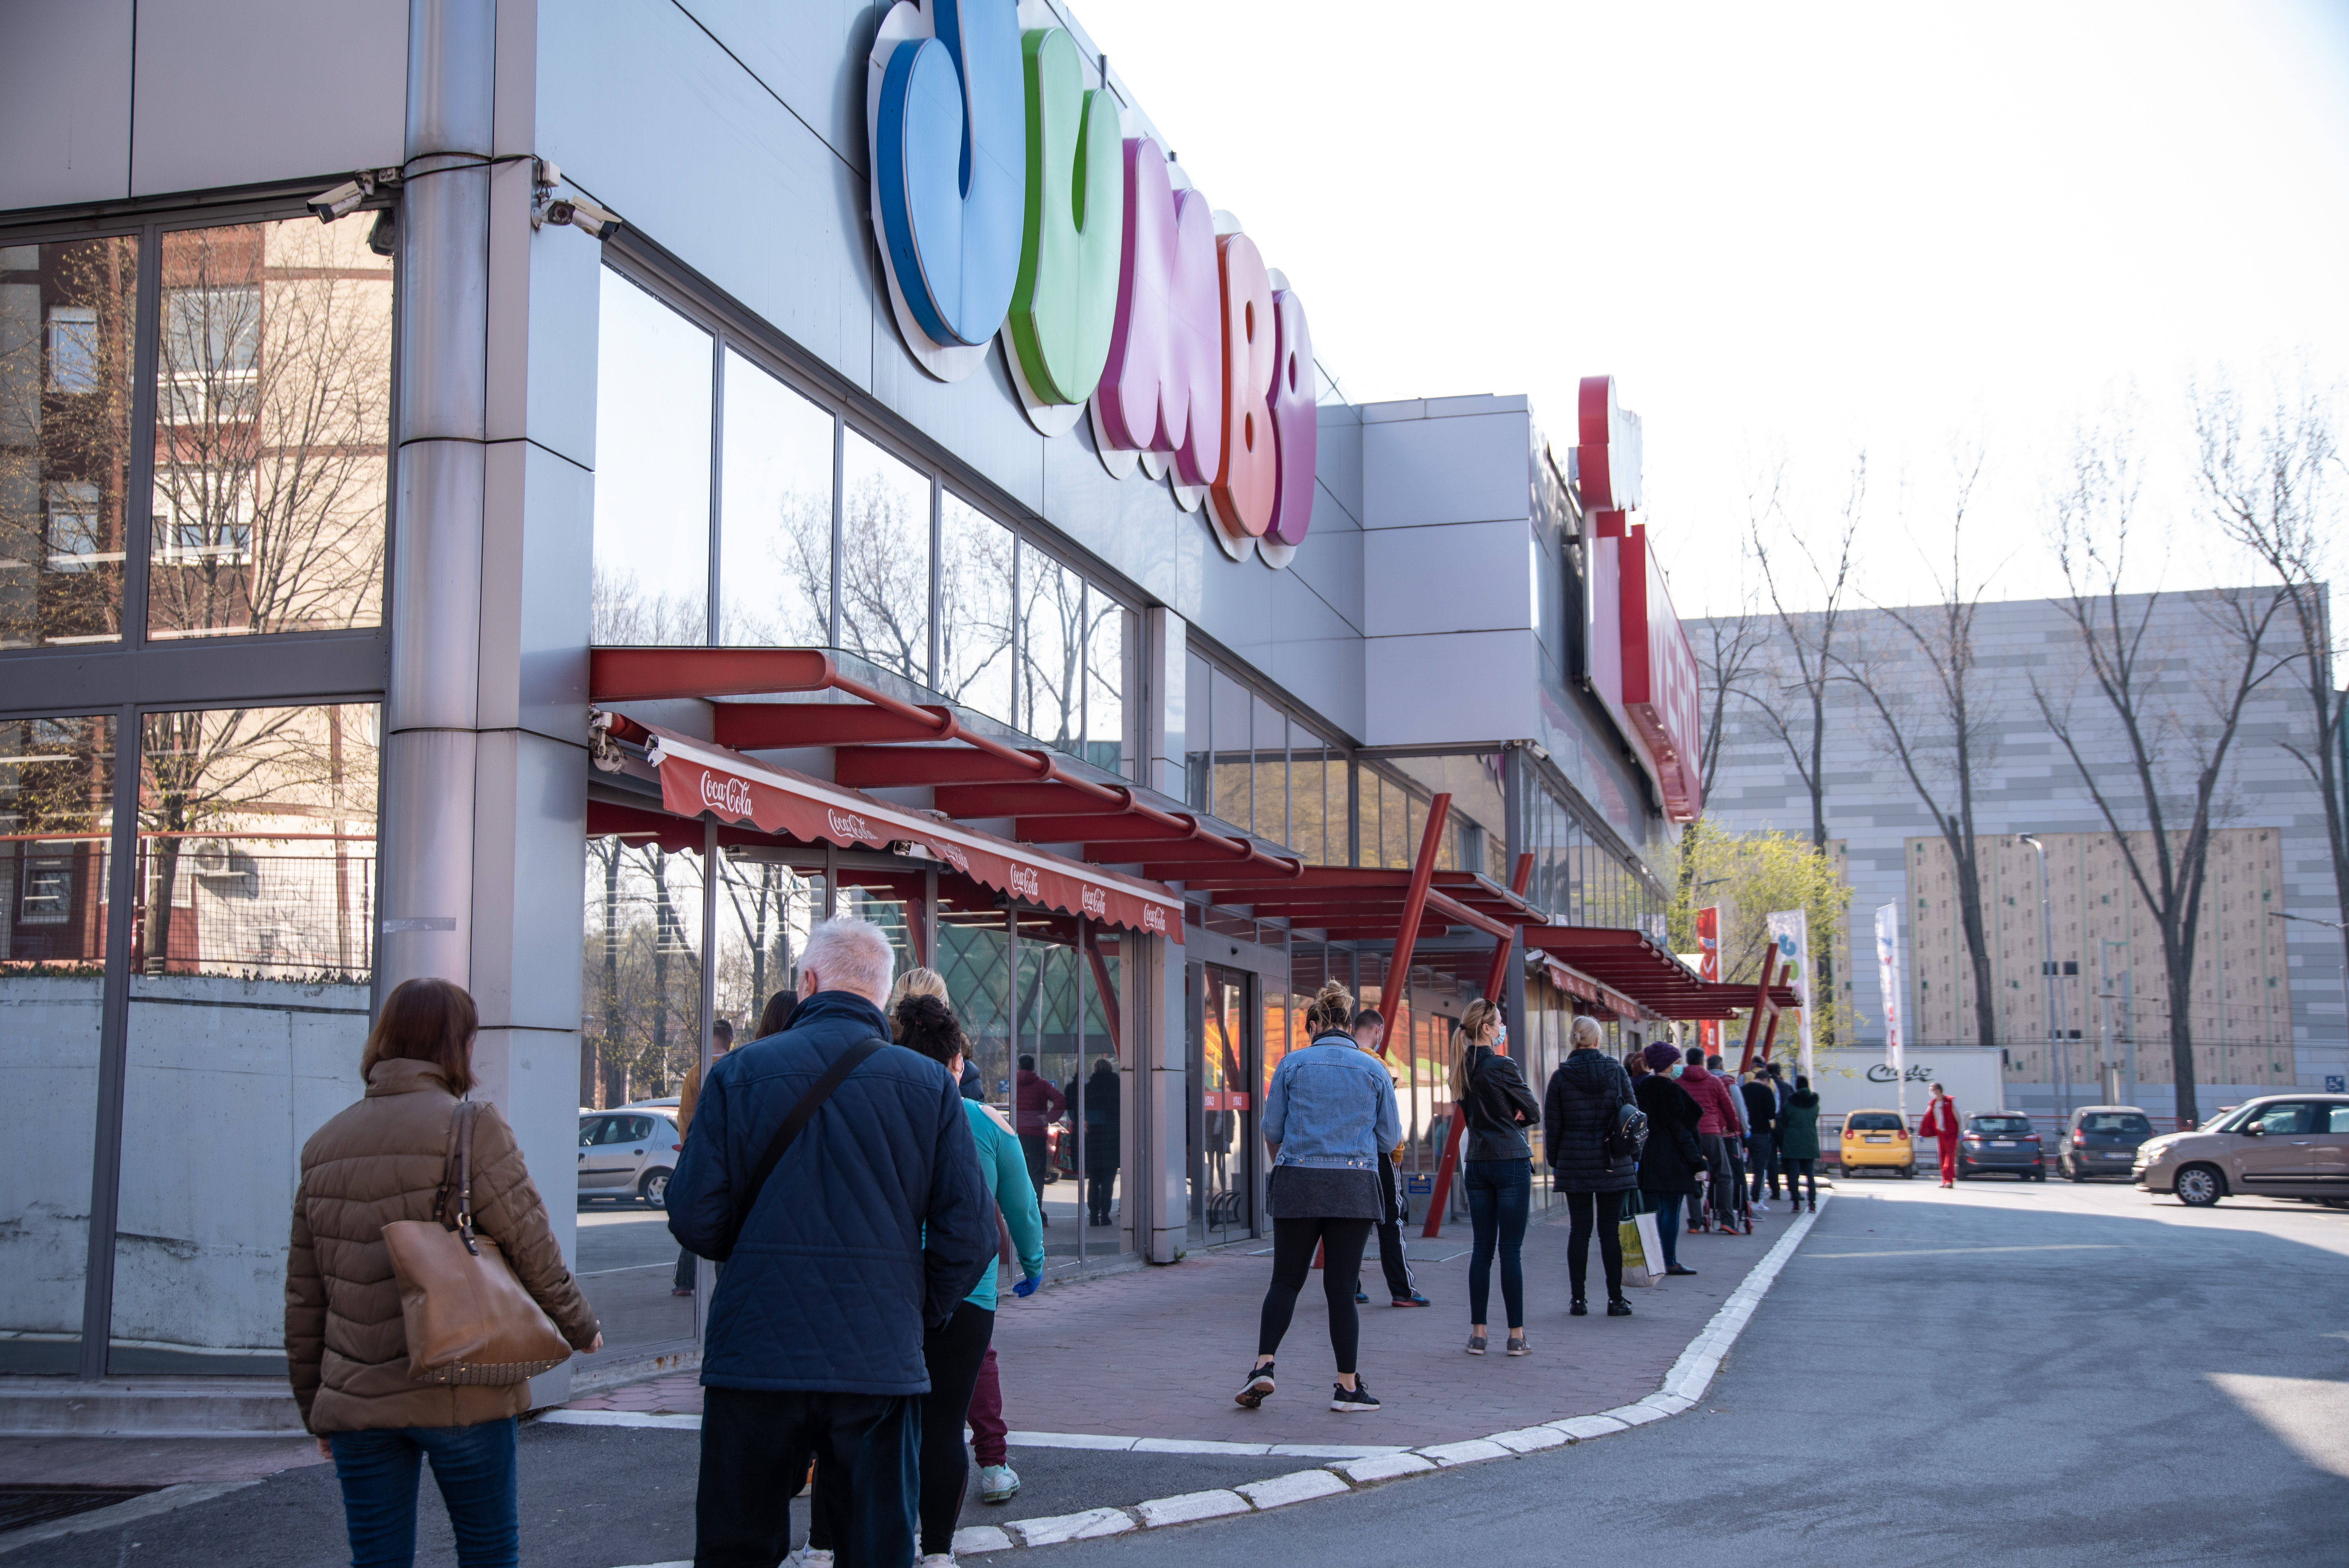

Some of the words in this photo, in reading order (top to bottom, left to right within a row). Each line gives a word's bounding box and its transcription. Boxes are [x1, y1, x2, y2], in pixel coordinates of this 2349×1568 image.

[701, 770, 753, 816] Coca-Cola
[828, 808, 879, 840] Coca-Cola
[1010, 863, 1039, 896] Coca-Cola
[1082, 884, 1106, 915] Coca-Cola
[1144, 903, 1166, 931] Coca-Cola
[1205, 1096, 1214, 1106] УЛАЗ
[1233, 1096, 1242, 1106] УЛАЗ
